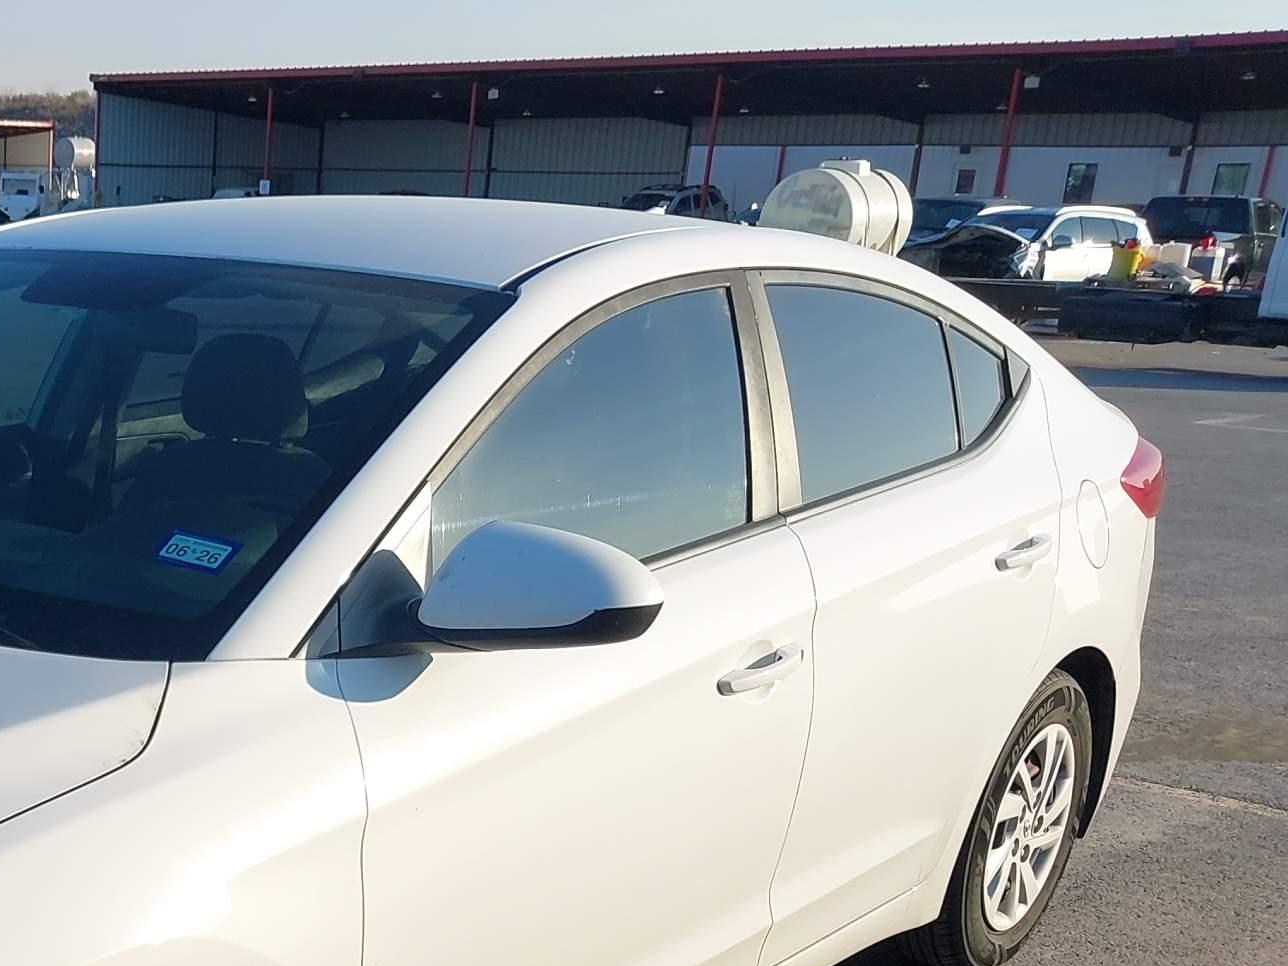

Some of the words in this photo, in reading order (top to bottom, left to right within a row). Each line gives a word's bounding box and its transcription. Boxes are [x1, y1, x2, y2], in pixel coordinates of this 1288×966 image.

[166, 543, 190, 557] 06
[195, 549, 221, 564] 26
[1003, 696, 1055, 777] TOURING
